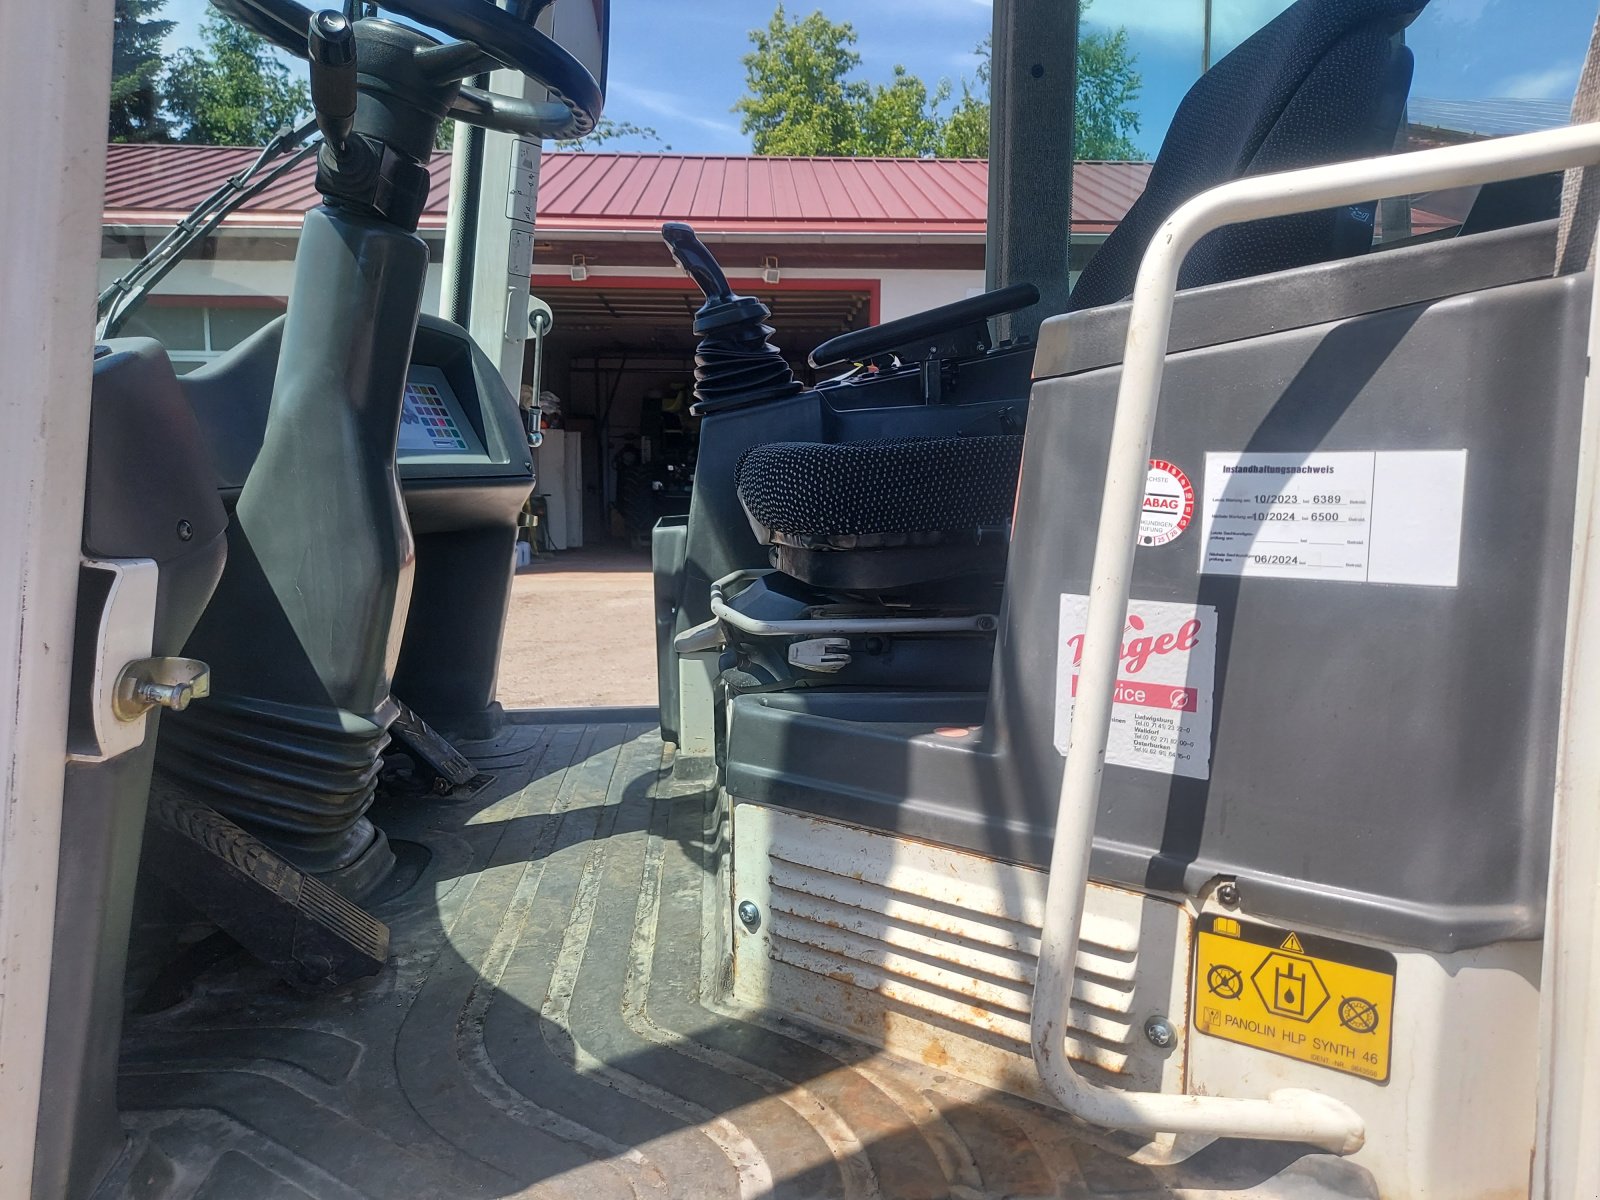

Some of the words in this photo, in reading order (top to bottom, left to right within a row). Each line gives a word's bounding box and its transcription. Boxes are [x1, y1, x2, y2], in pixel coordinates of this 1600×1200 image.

[1223, 465, 1334, 474] Instandhaltungsnachweis
[1143, 497, 1179, 509] ABAG
[1254, 495, 1298, 504] 10/2023
[1313, 495, 1341, 504] 6389
[1253, 512, 1295, 521] 10/2024
[1311, 512, 1339, 521] 6500
[1254, 555, 1298, 564] 06/2024
[1134, 713, 1174, 725] Ludwigsburg
[1134, 726, 1160, 735] Walldorf
[1134, 740, 1171, 750] Osterburken
[1224, 1014, 1276, 1038] PANOLIN
[1282, 1030, 1306, 1045] HLP
[1312, 1038, 1356, 1059] SYNTH
[1362, 1052, 1378, 1065] 46
